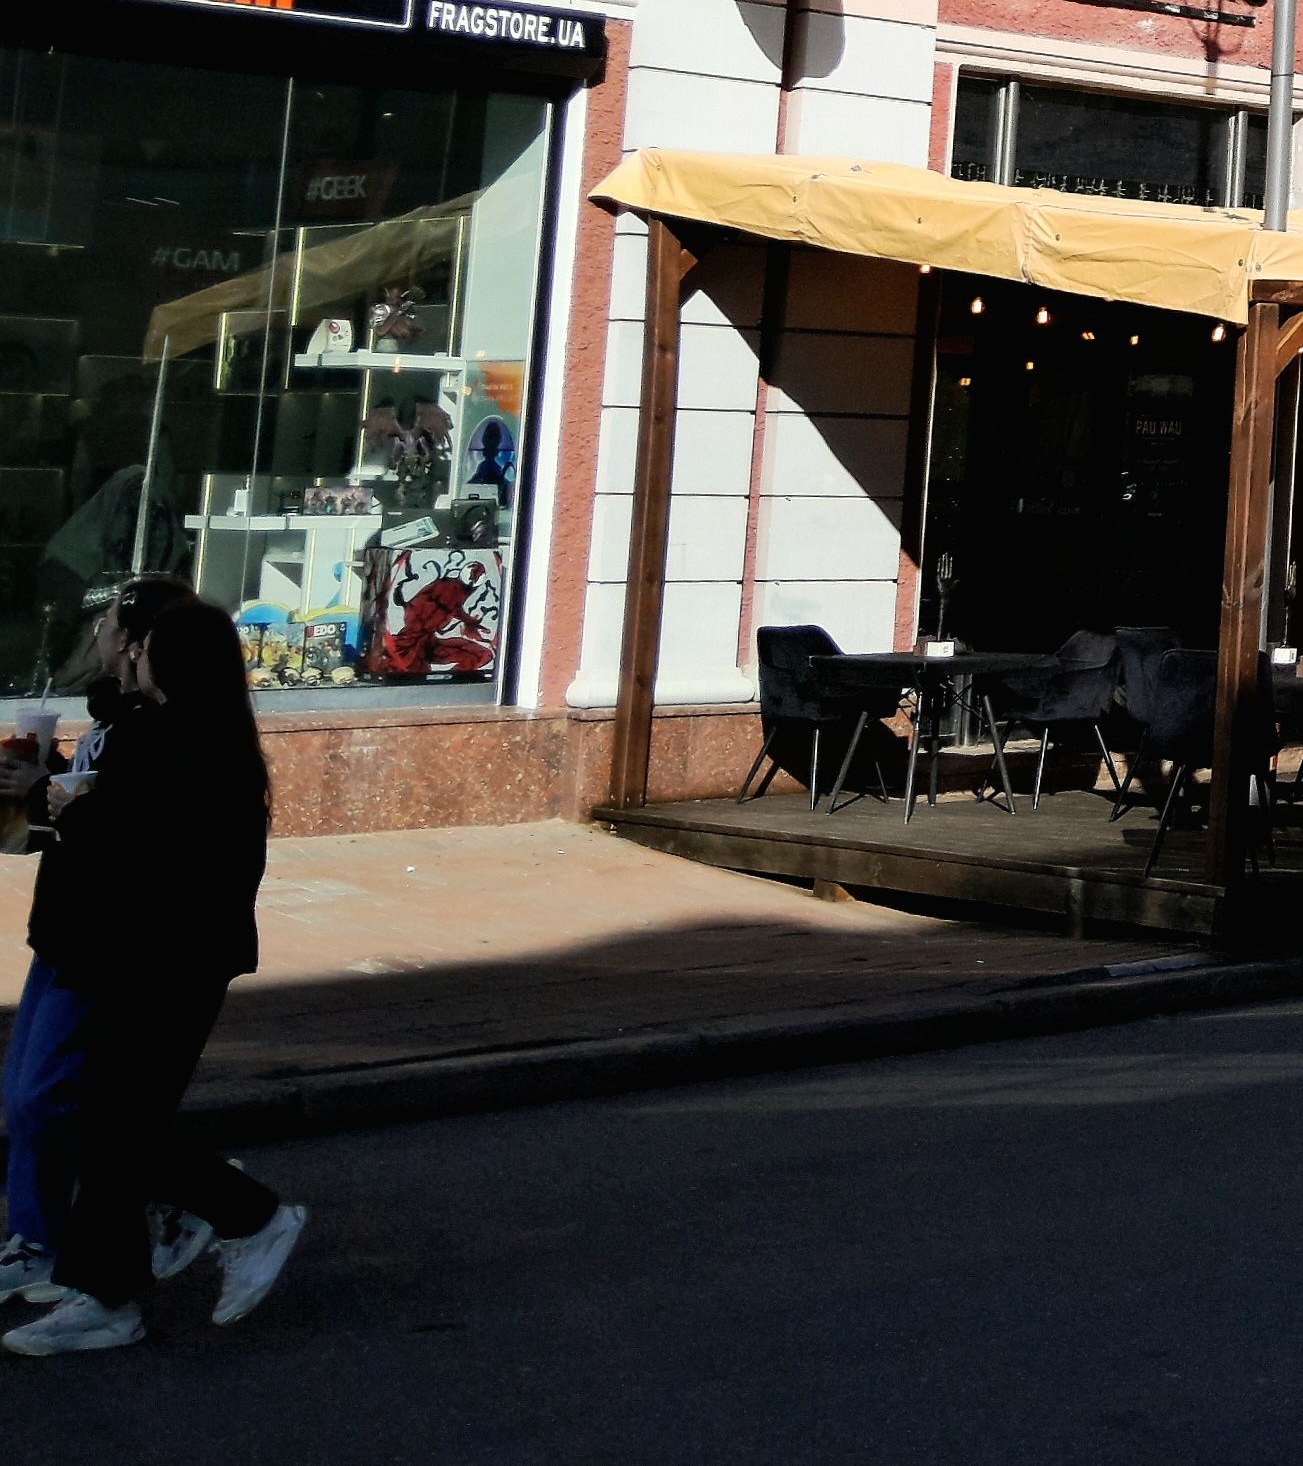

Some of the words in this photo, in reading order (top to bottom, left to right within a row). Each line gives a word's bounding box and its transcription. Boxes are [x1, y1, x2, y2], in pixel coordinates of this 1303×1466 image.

[428, 0, 585, 48] FRAGSTORE.UA
[307, 175, 368, 201] #GEEK
[1136, 420, 1156, 435] PAU
[1160, 420, 1182, 435] WAU
